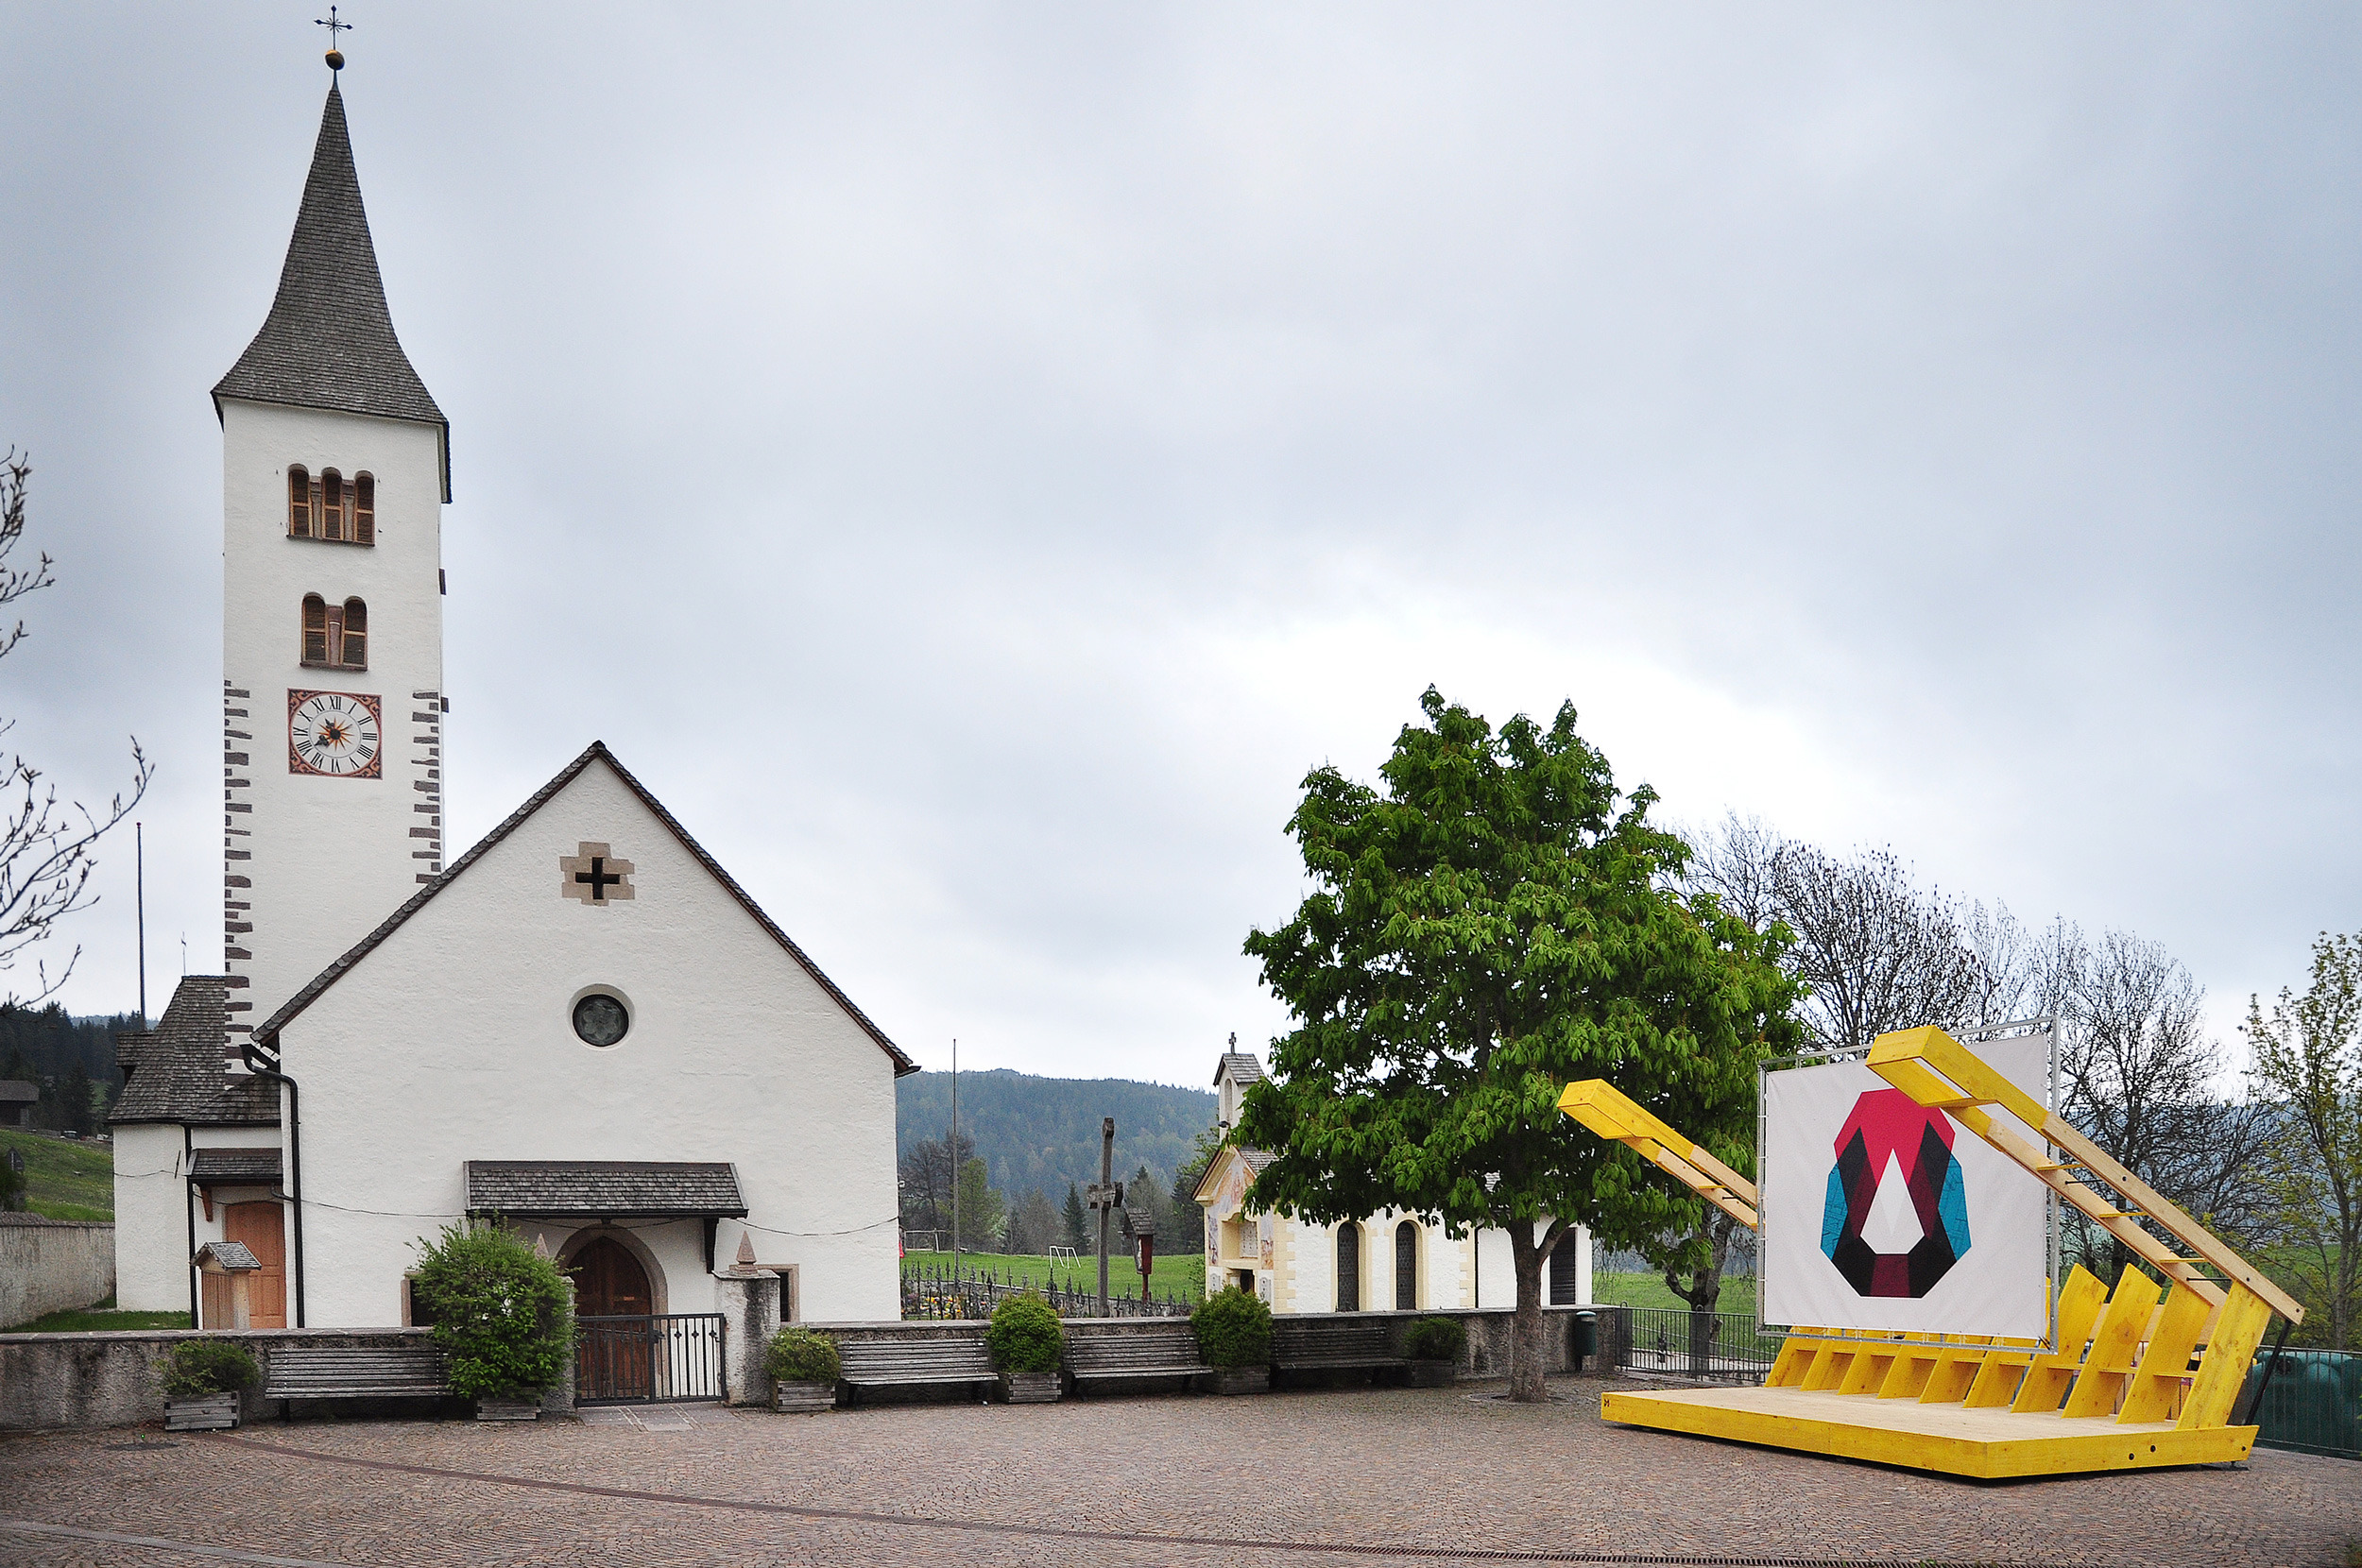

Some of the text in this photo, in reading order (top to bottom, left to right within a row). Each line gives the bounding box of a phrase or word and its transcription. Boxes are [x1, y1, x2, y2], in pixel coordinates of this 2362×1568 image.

[311, 698, 325, 713] XI
[330, 695, 341, 710] XII
[357, 715, 373, 725] II
[362, 732, 377, 741] III
[310, 752, 325, 769] VII
[331, 758, 341, 773] VI
